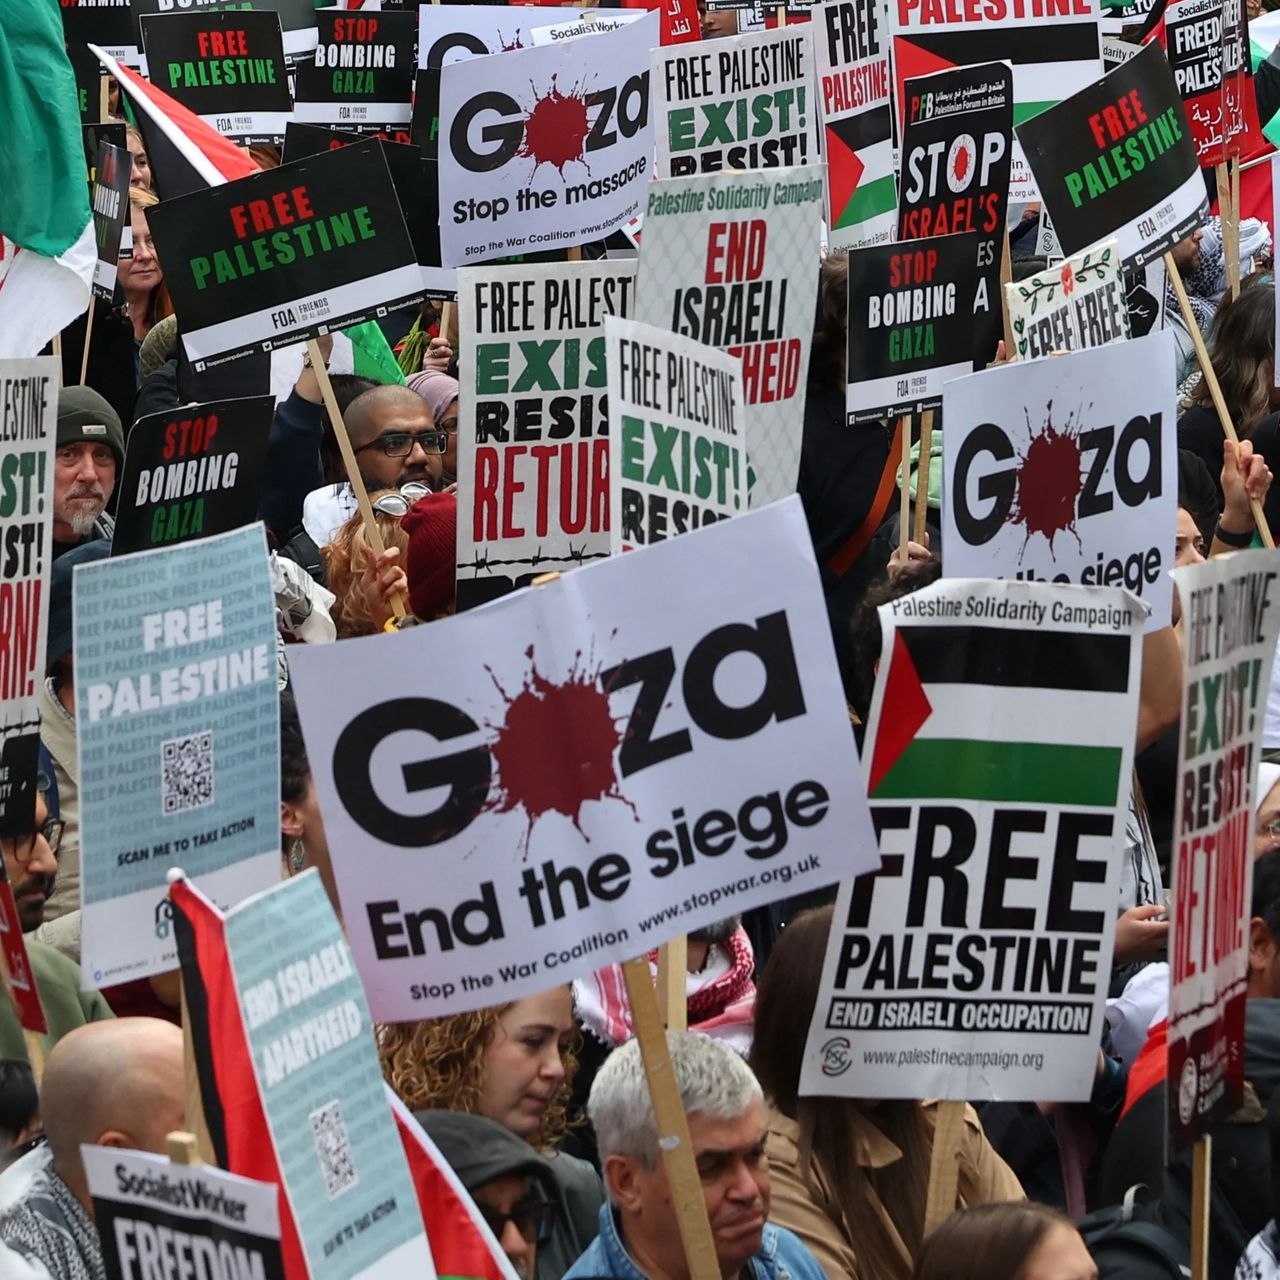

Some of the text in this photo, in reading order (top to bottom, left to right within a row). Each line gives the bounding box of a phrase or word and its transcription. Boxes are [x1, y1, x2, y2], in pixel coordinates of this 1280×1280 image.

[449, 69, 650, 173] Gza
[910, 92, 934, 123] PFB
[453, 155, 648, 224] Stop the massacre
[905, 131, 1006, 204] STOP
[229, 185, 315, 241] FREE
[902, 192, 1000, 241] ISRAEL'S
[189, 205, 377, 291] PALESTINE
[272, 297, 329, 329] FOA FRIENDS
[143, 599, 223, 653] FREE
[892, 595, 1132, 629] Palestine Solidarity Campaign
[88, 644, 269, 721] PALESTINE
[333, 609, 807, 848] Gza
[117, 816, 255, 867] SCAN ME TO TAKE ACTION
[366, 779, 830, 961] End the siege
[846, 805, 1115, 934] FREE
[410, 853, 821, 1002] Stop the War Coalition www.stopwar.org.uk
[244, 942, 351, 1028] END ISRAELI
[833, 933, 1100, 996] PALESTINE
[264, 1002, 363, 1086] APARTHEID
[829, 1000, 1090, 1033] END ISRAELI OCCUPATION
[862, 1046, 1045, 1072] www.palestinecampaign.org
[116, 1164, 248, 1223] Socialist Worker
